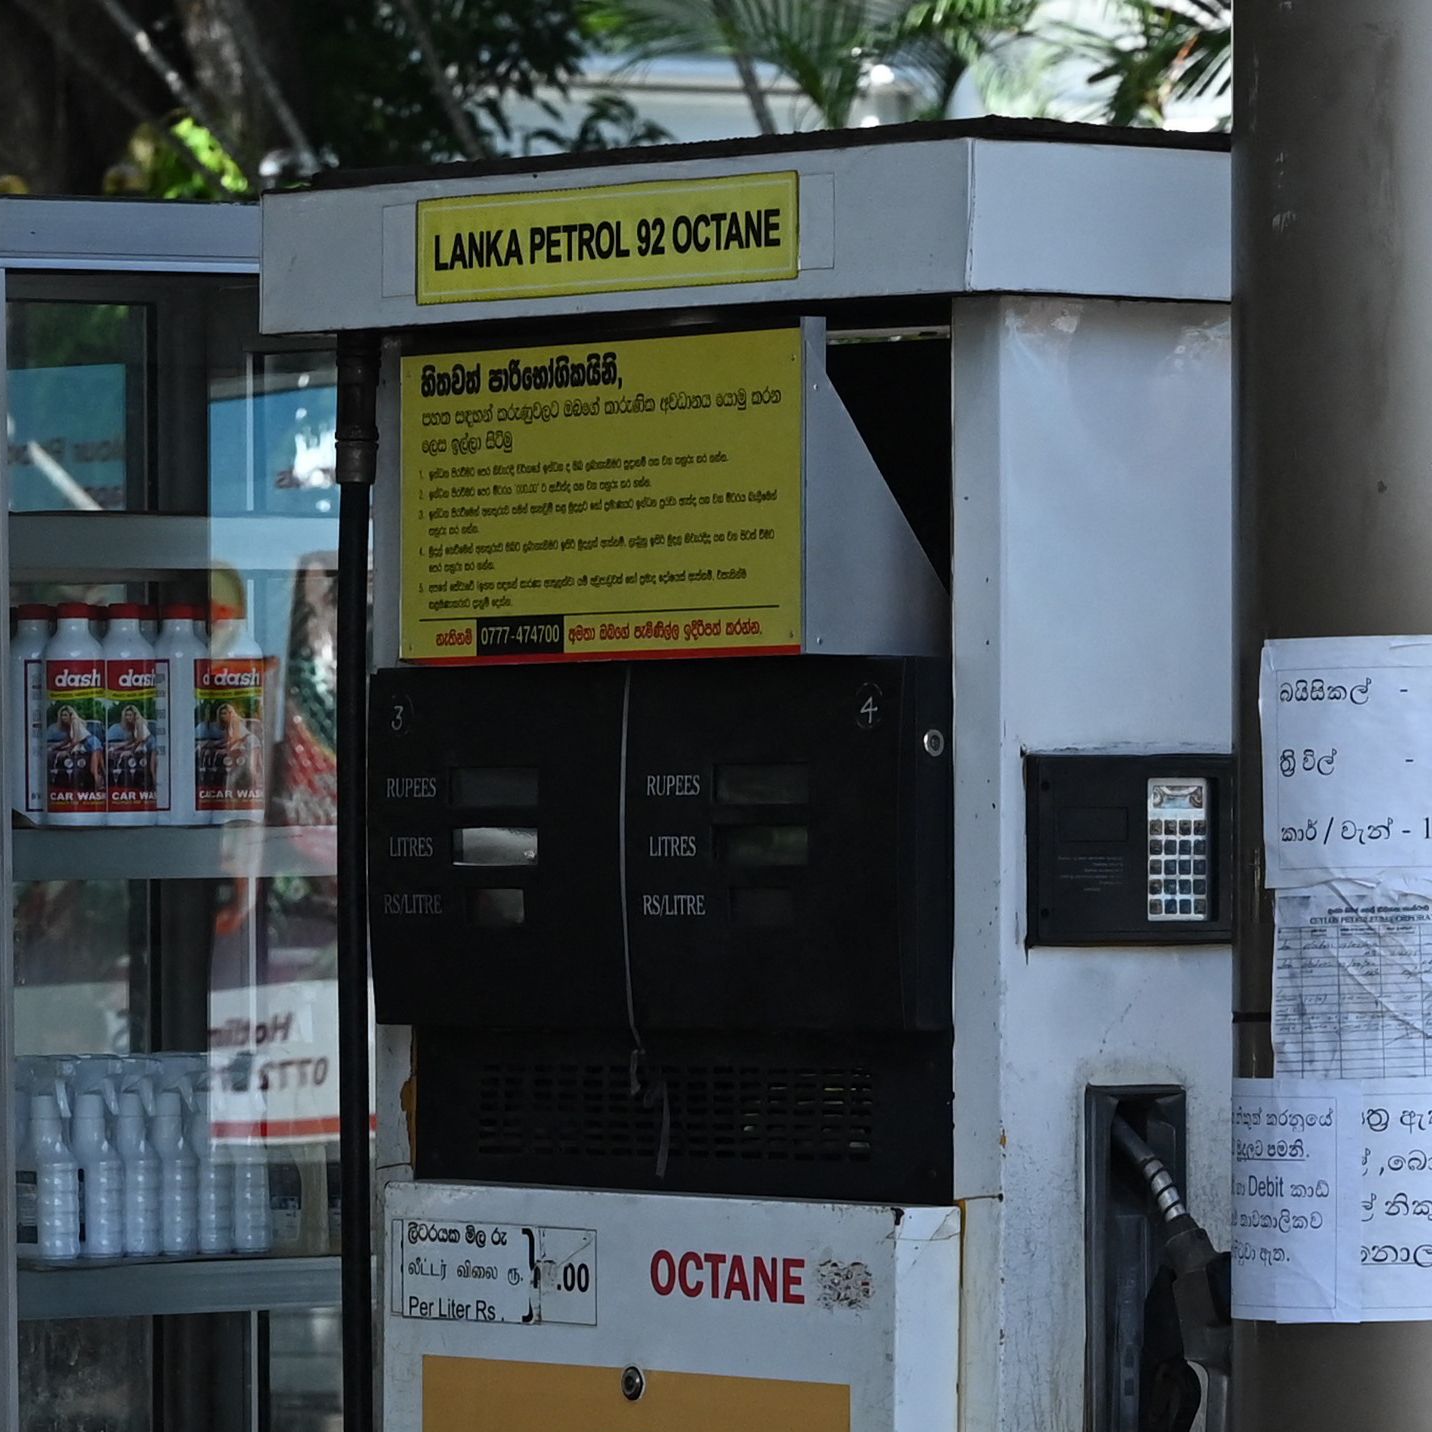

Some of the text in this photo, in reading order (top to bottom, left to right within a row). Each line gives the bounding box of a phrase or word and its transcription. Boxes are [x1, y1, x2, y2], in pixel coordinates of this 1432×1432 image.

[433, 207, 782, 272] LANKA PETROL 92 OCTANE
[752, 388, 782, 407] කරන
[480, 622, 561, 647] 0777-474700
[55, 668, 101, 688] dash
[214, 667, 260, 688] dash
[1279, 678, 1373, 706] බයිසිකල්
[390, 704, 406, 731] 3
[858, 695, 879, 725] 4
[1302, 748, 1338, 776] විල්
[50, 791, 74, 801] CAR
[111, 791, 136, 801] CAR
[386, 776, 438, 800] RUPEES
[646, 773, 702, 798] RUPEES
[1280, 819, 1319, 843] කාර්
[1340, 817, 1394, 845] වැන්
[388, 836, 435, 859] LITRES
[649, 834, 698, 859] LITRES
[383, 893, 443, 917] RS/LITRE
[642, 893, 707, 917] RS/LITRE
[1248, 1175, 1284, 1198] Debit
[649, 1249, 806, 1306] OCTANE
[408, 1295, 435, 1317] Per
[438, 1297, 472, 1320] Liter
